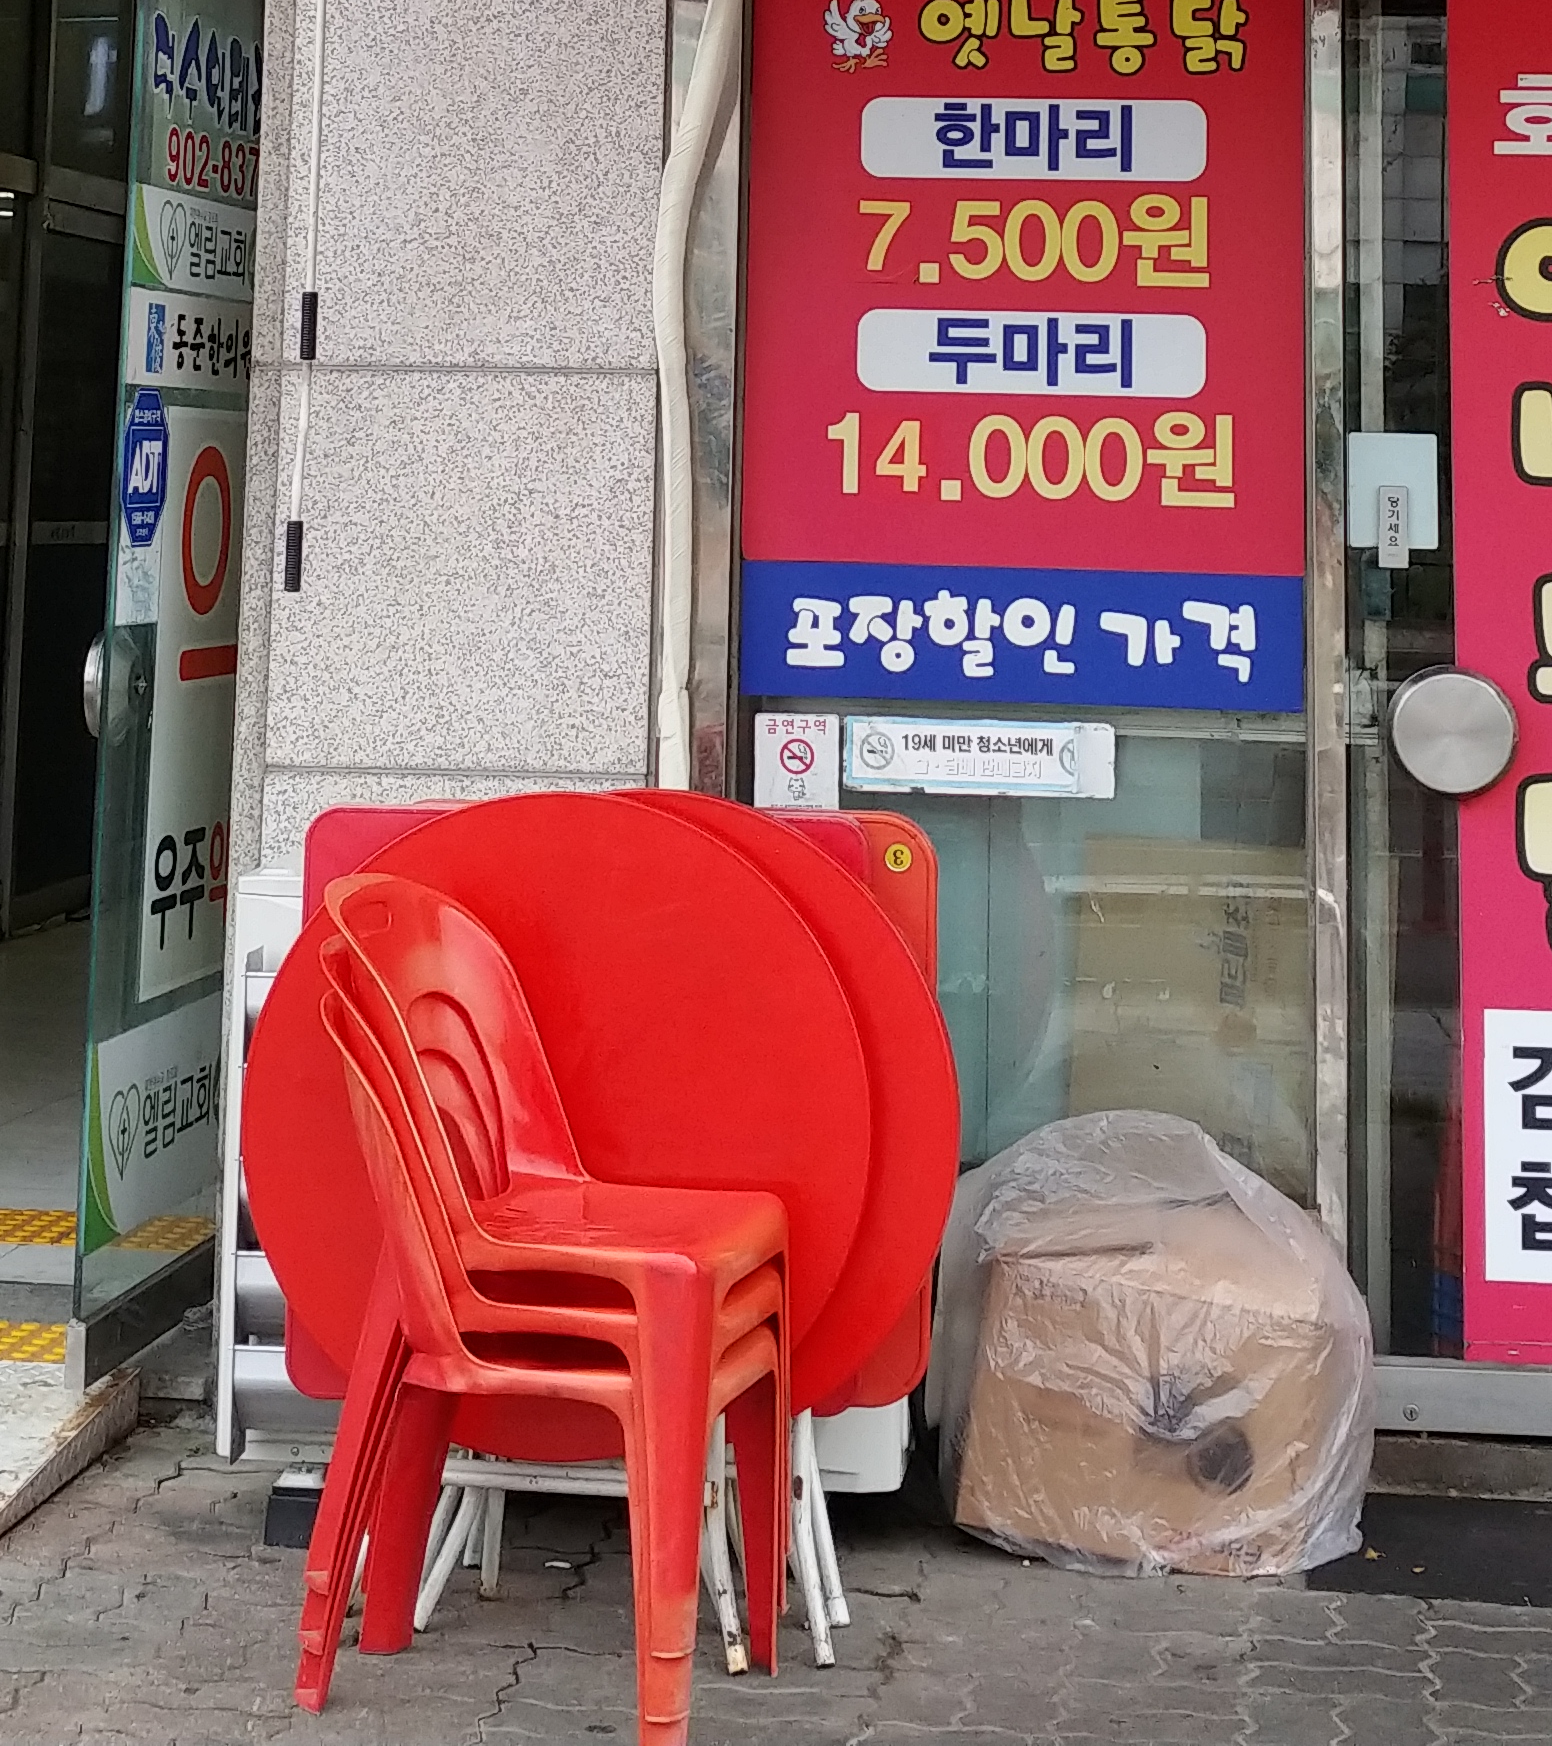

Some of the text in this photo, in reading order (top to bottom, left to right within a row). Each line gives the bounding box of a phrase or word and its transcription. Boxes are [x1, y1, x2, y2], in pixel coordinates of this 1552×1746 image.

[934, 103, 1133, 173] 한마리
[189, 221, 247, 286] 엘림교회
[858, 194, 1211, 290] 7.500원
[928, 318, 1133, 388] 두마리
[128, 440, 162, 493] ADT
[827, 411, 1236, 508] 14.000원
[1387, 496, 1400, 547] 당기세요
[785, 589, 1257, 683] 포장할인 가격
[765, 718, 827, 736] 금연구역
[901, 733, 1054, 757] 19세 미만 청소년에게
[143, 1063, 212, 1159] 엘림교회
